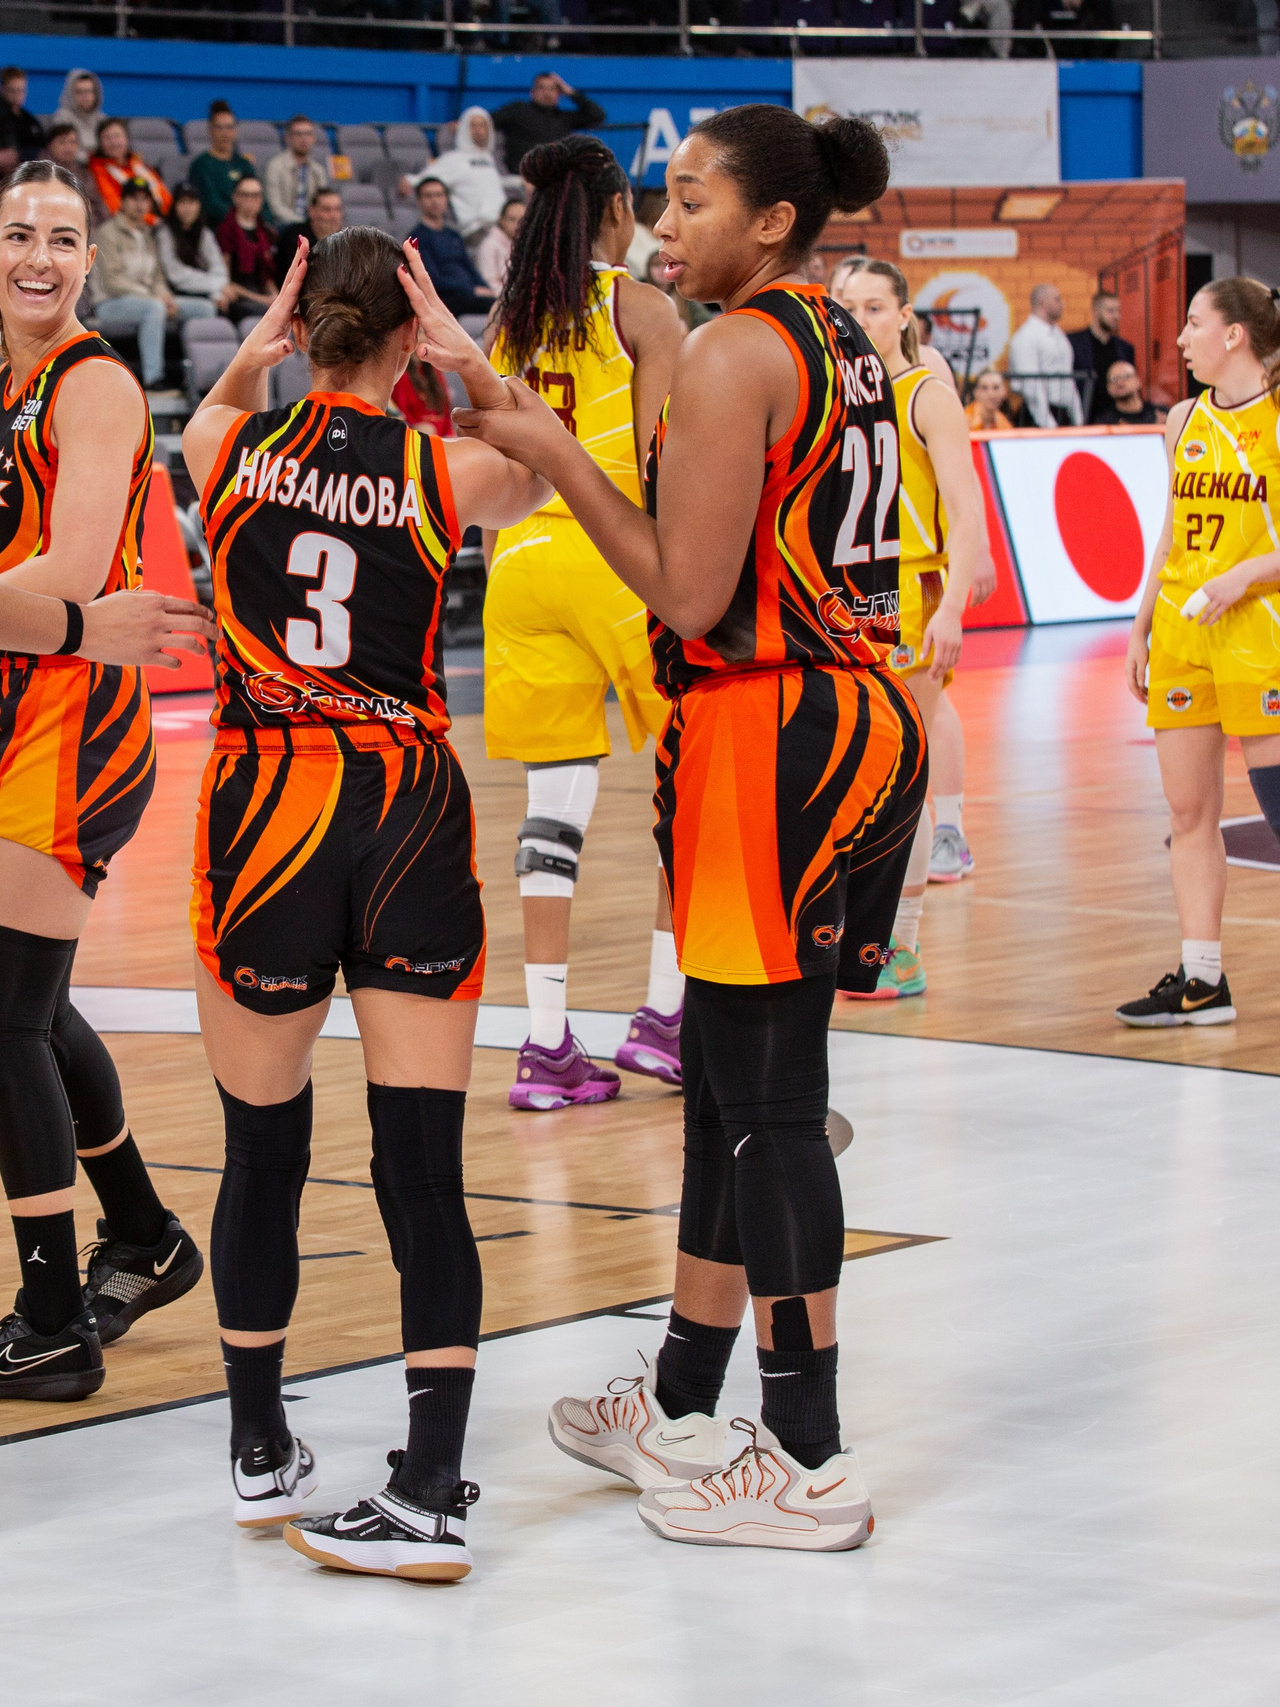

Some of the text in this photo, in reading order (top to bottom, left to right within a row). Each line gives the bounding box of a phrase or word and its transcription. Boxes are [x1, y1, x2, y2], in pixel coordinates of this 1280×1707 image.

[233, 447, 422, 527] НИЗАМОВА
[832, 420, 900, 567] 22
[1172, 472, 1267, 502] АДЕЖДА
[1187, 514, 1224, 551] 27
[286, 531, 358, 668] 3
[850, 590, 899, 618] УГМ
